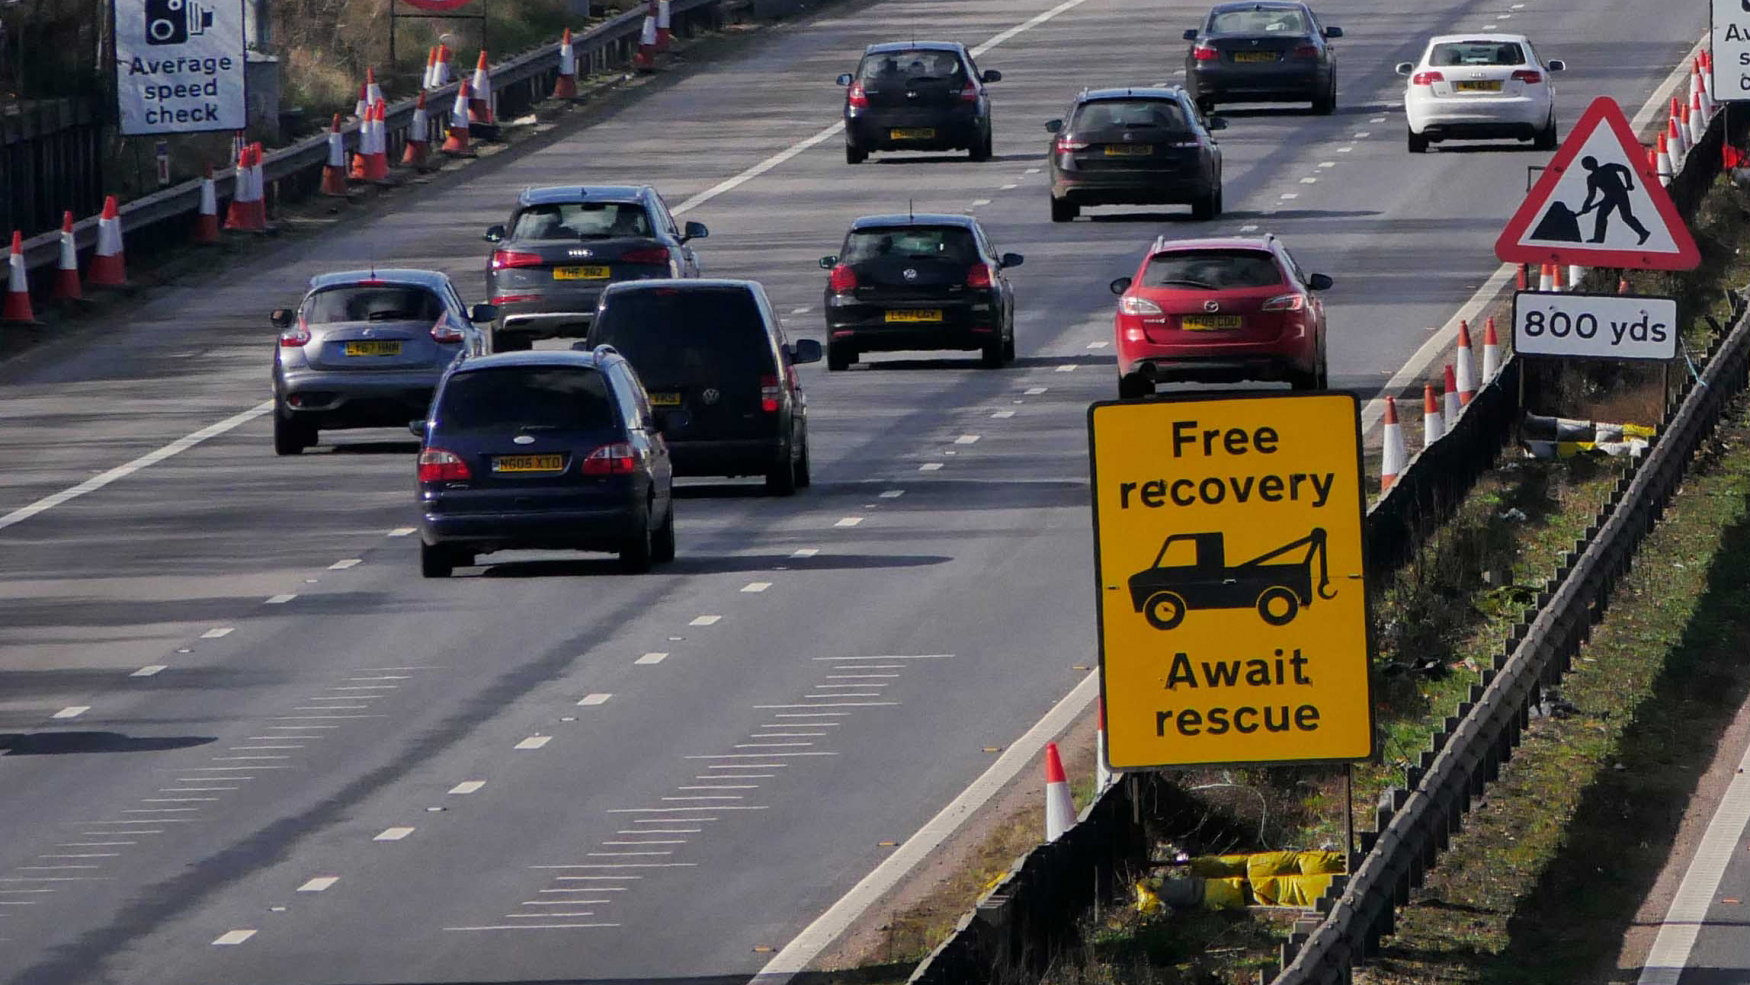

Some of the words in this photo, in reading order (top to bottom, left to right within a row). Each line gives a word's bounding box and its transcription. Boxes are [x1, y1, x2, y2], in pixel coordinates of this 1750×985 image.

[129, 57, 231, 76] Average
[145, 78, 218, 101] speed
[145, 103, 218, 124] check
[1525, 313, 1597, 338] 800
[1611, 319, 1667, 345] yds
[1173, 421, 1278, 457] Free
[1121, 473, 1334, 509] recovery
[1165, 649, 1312, 689] Await
[1157, 705, 1319, 736] rescue
